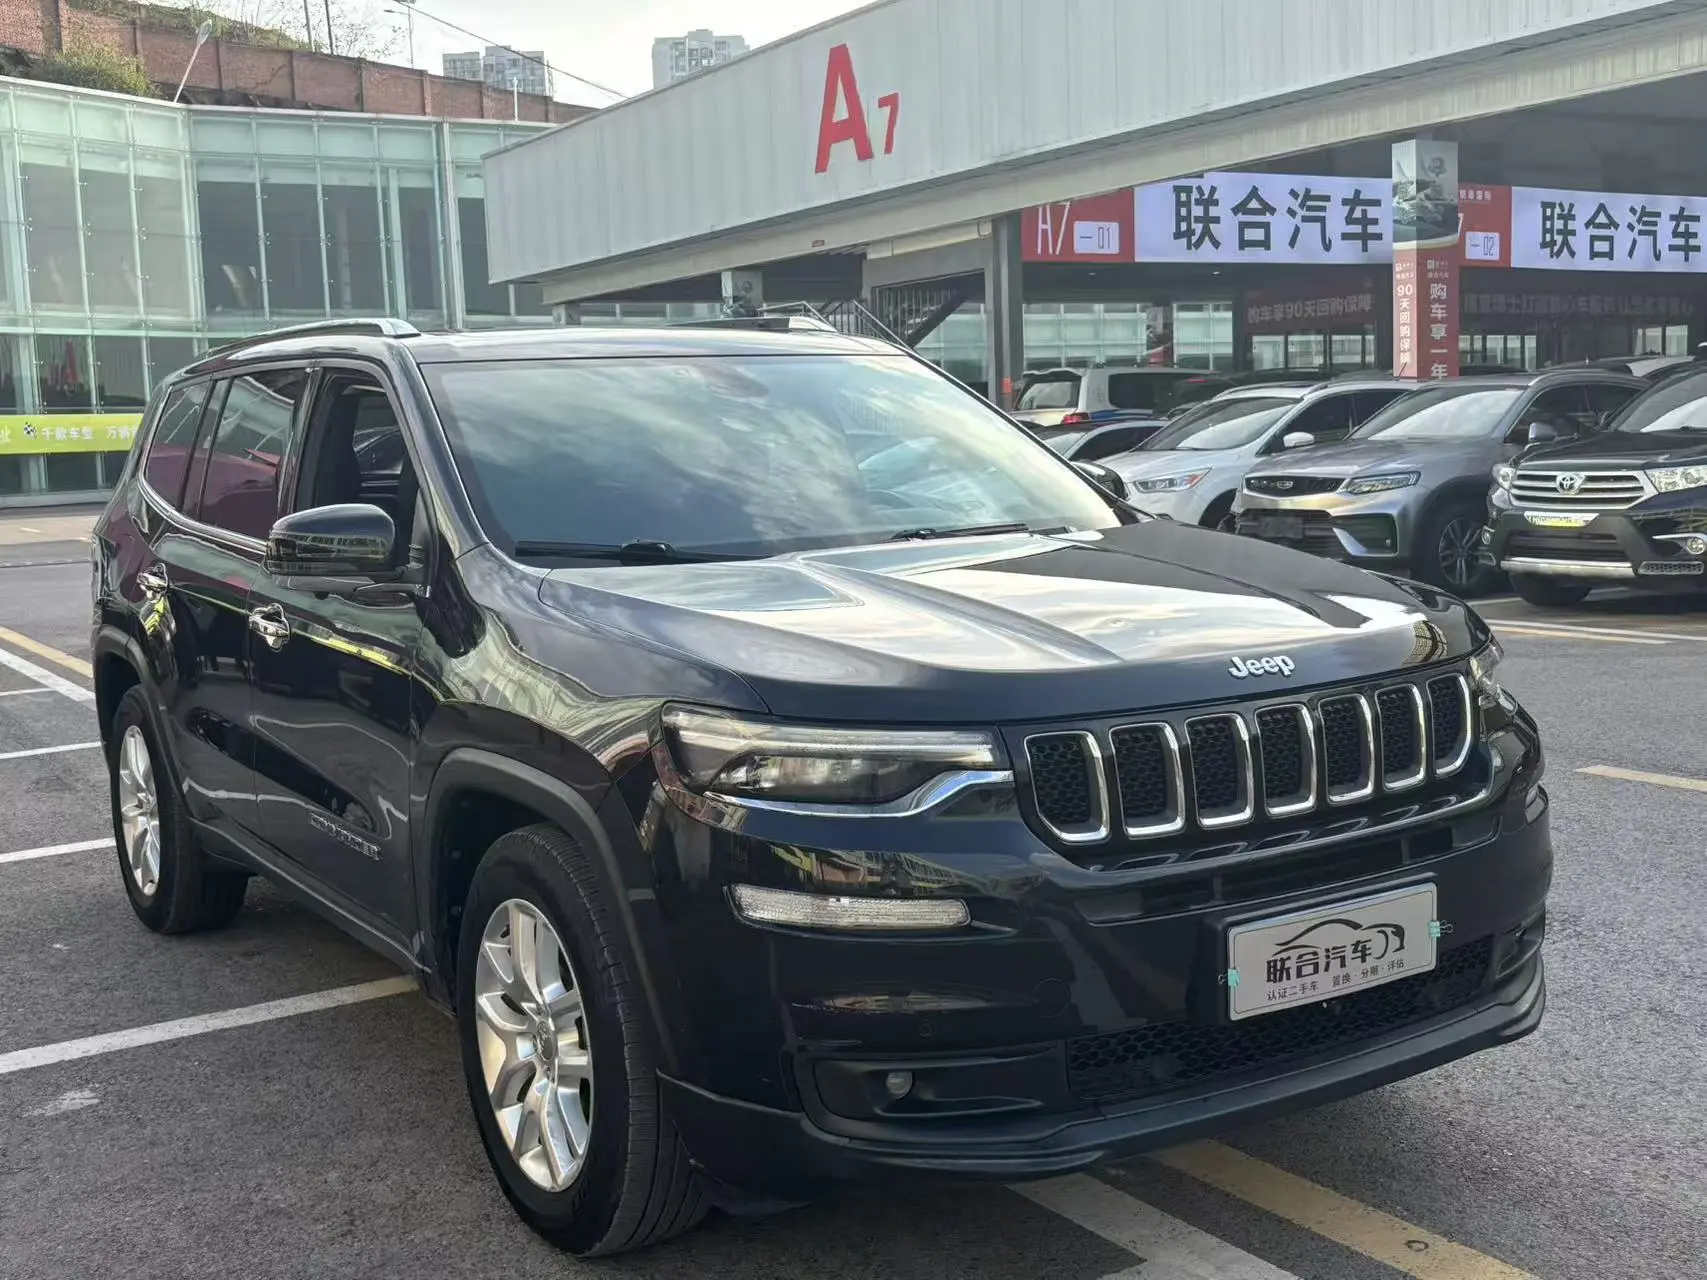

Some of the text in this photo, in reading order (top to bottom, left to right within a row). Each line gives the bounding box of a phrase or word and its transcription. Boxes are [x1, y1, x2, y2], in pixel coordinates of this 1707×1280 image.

[1172, 185, 1383, 252] 联合汽车
[1540, 201, 1701, 262] 联合汽车
[1228, 655, 1295, 678] Jeep
[1266, 939, 1372, 983] 联合汽车
[1267, 981, 1319, 1000] 认证二手车
